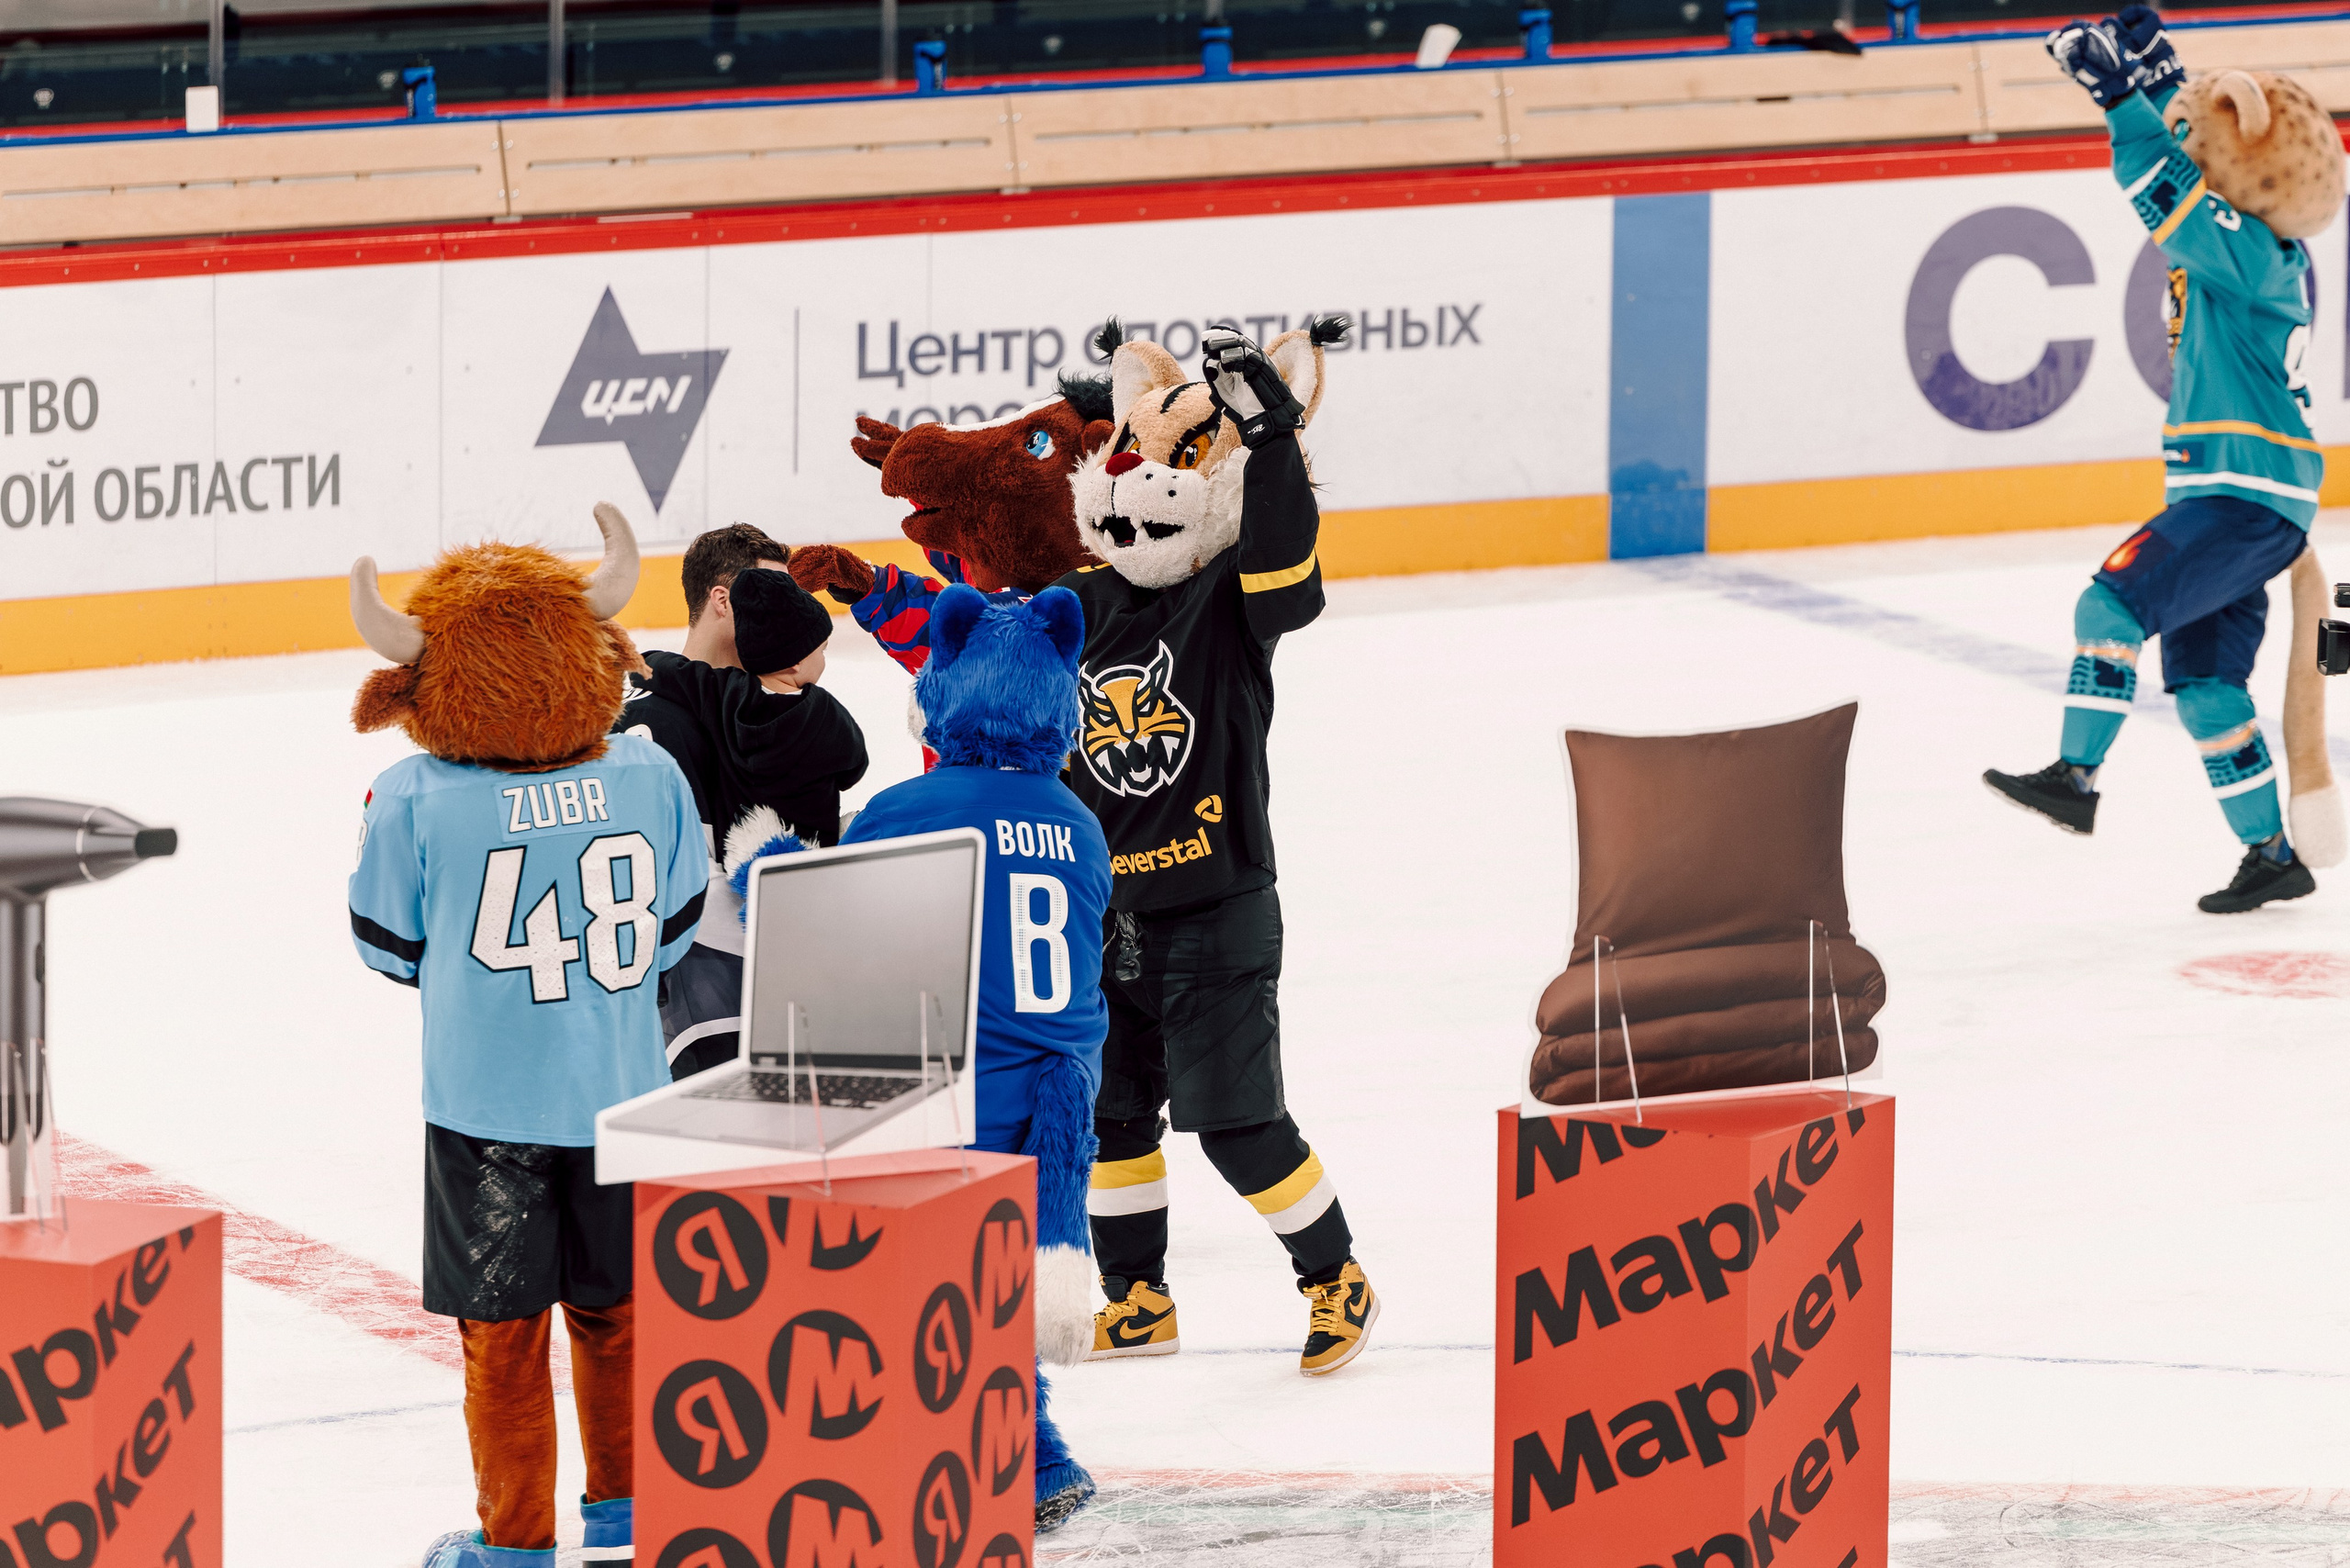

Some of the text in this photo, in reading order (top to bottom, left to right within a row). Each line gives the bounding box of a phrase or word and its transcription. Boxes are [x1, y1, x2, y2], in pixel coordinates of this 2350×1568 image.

[857, 320, 1065, 388] Центр
[0, 376, 99, 435] ТВО
[0, 454, 341, 529] ОЙ ОБЛАСТИ
[502, 777, 610, 834] ZUBR
[994, 819, 1076, 864] ВОЛК
[469, 830, 659, 1004] 48
[1009, 872, 1072, 1014] В
[1511, 1218, 1864, 1529] Маркет
